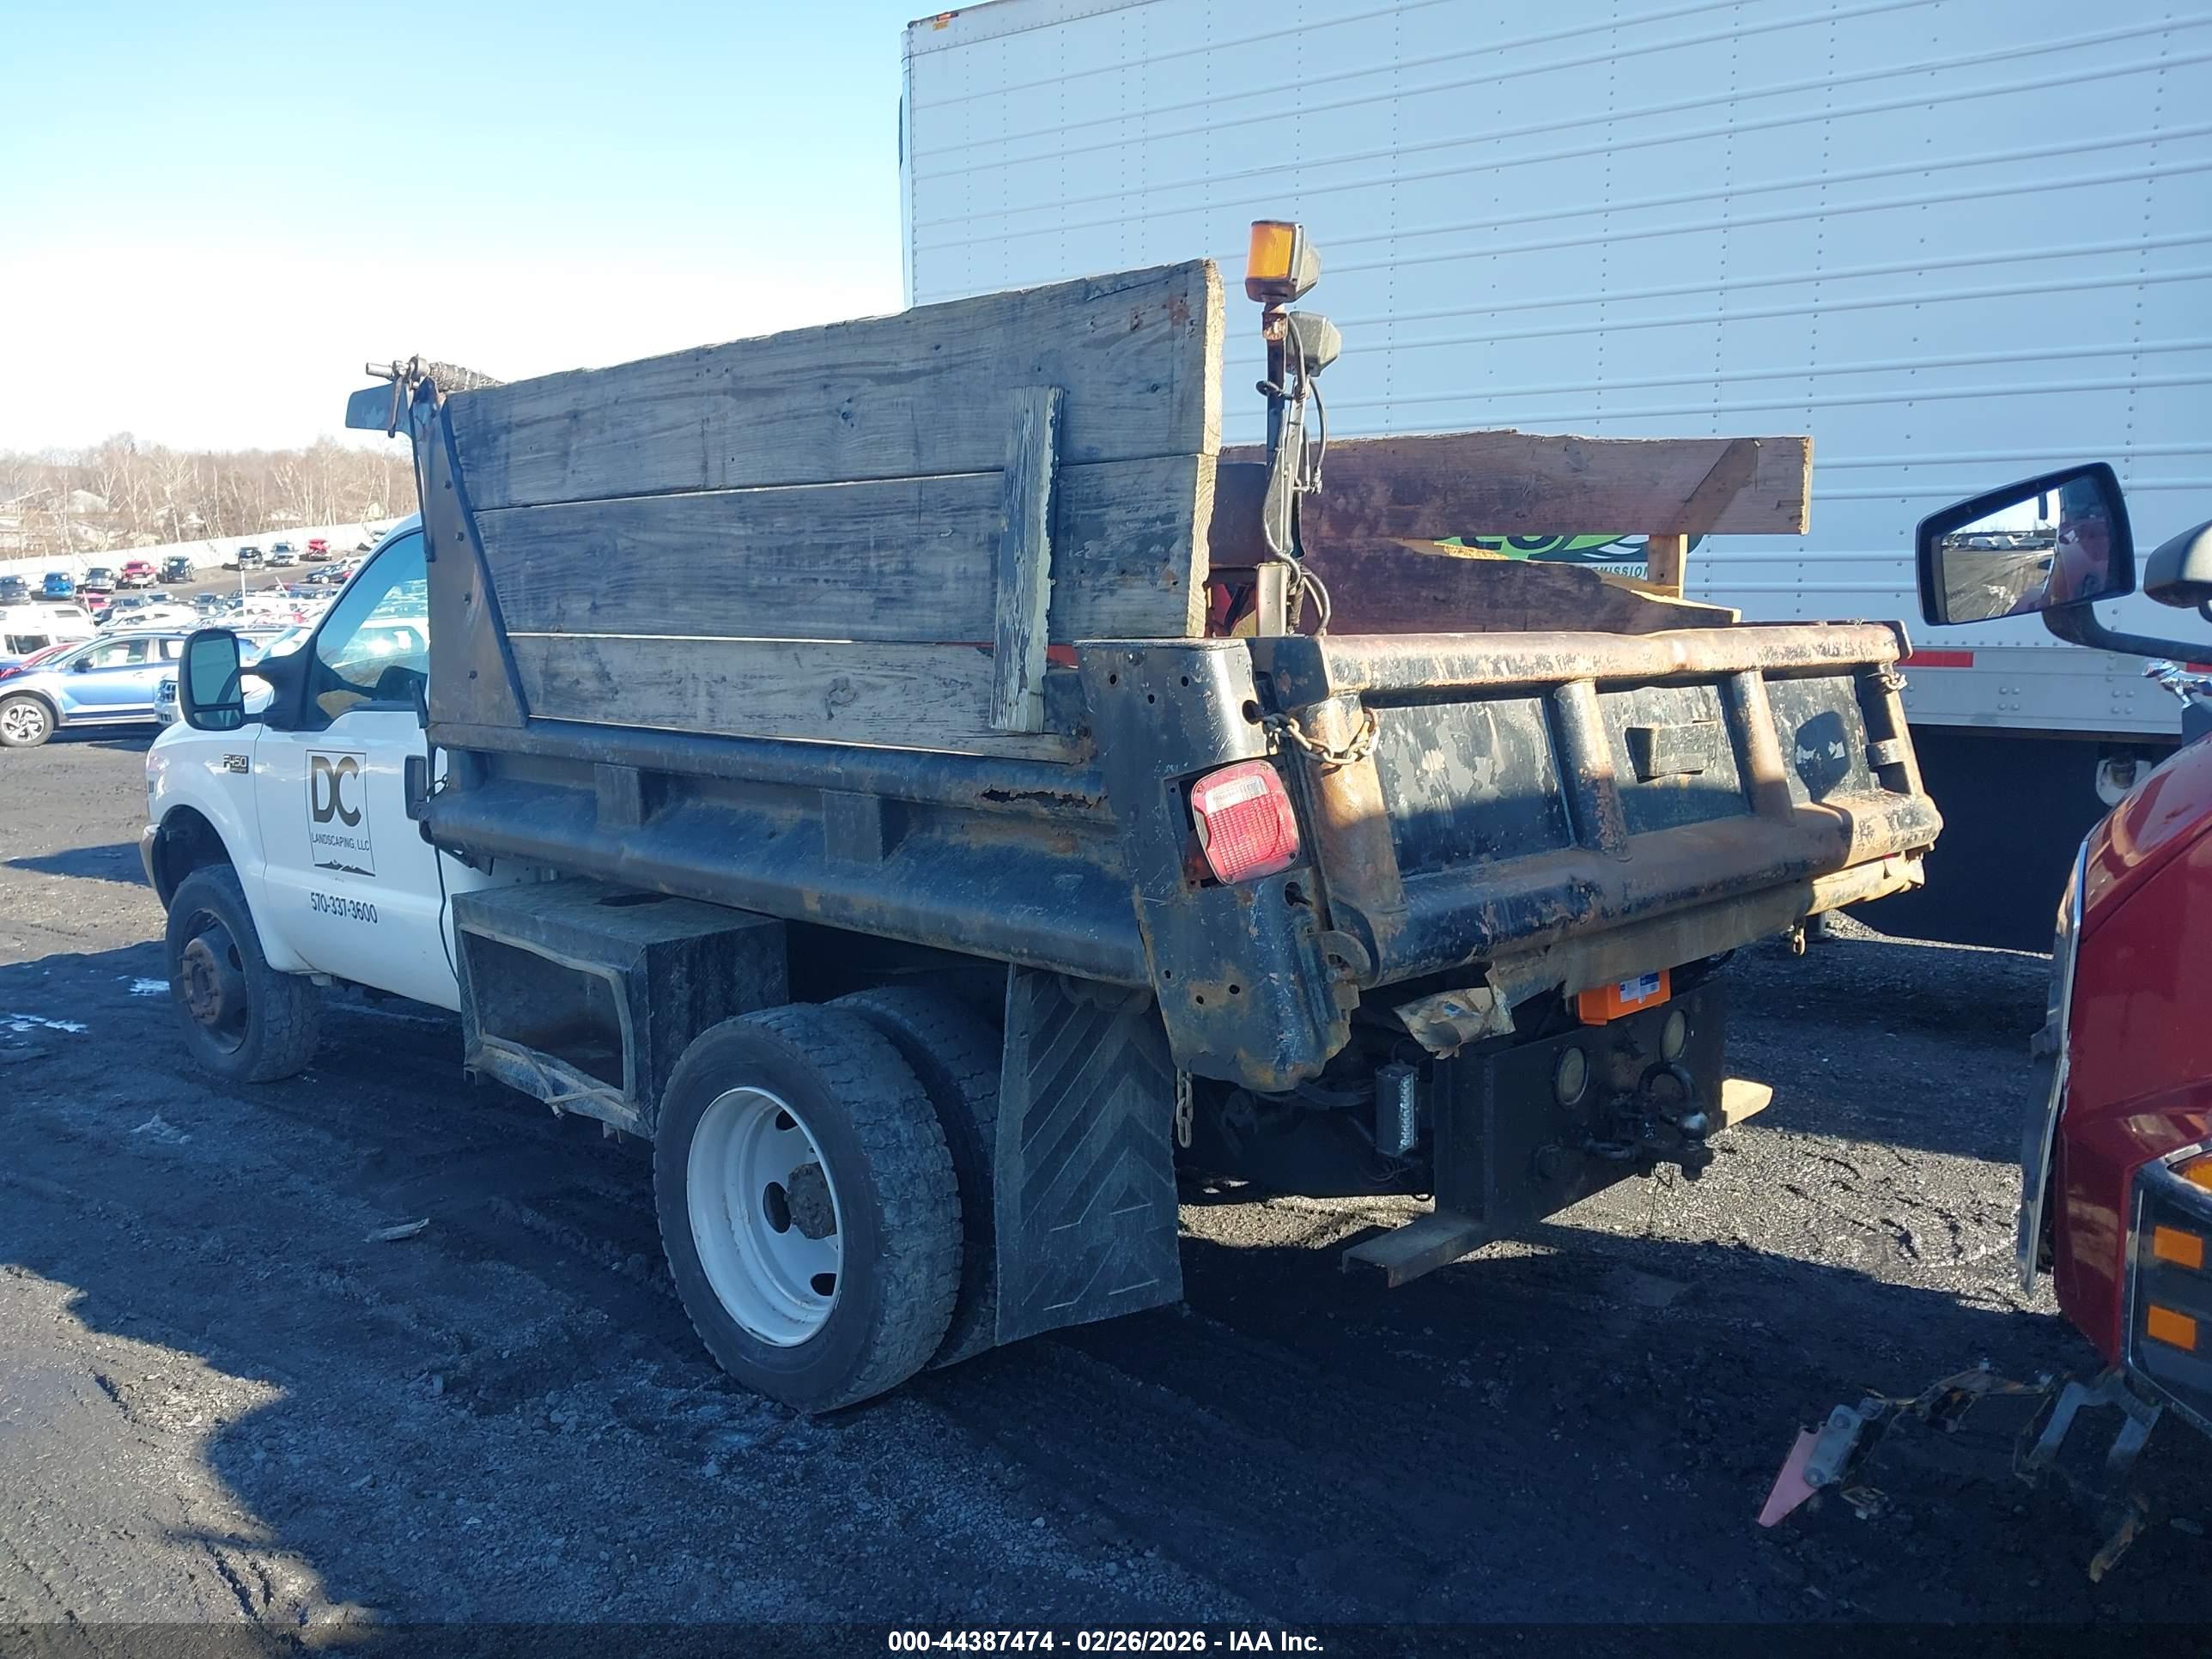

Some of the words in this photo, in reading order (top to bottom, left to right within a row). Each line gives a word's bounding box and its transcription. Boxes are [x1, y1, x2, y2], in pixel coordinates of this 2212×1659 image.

[312, 756, 362, 827] DC
[312, 833, 357, 851] LANDSCAPING,
[357, 839, 370, 851] LLC
[311, 892, 378, 924] 570-337-3600
